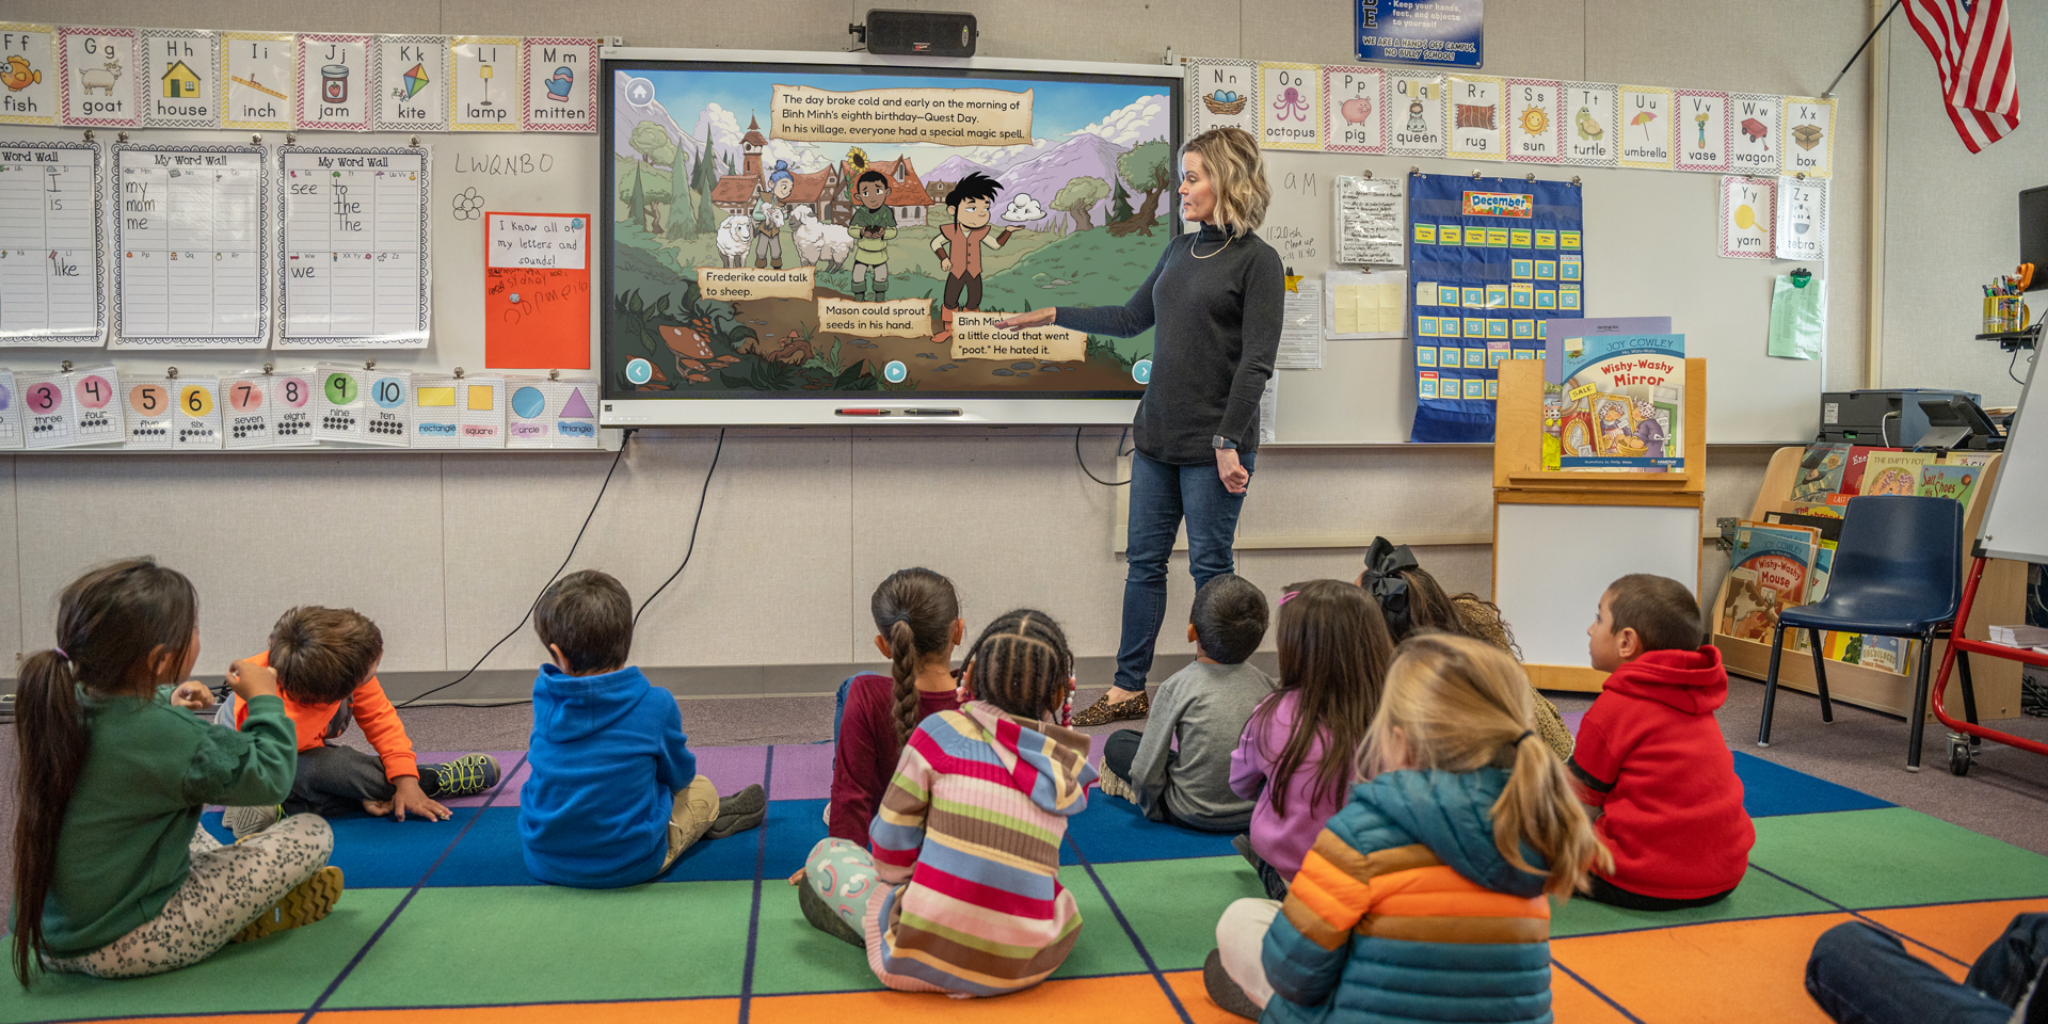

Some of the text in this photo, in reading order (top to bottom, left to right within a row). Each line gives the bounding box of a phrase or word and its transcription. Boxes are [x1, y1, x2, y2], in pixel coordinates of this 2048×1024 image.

[1393, 0, 1461, 13] Keep your hands,
[1392, 9, 1461, 21] feet, and objects
[1404, 20, 1437, 29] yourself
[1362, 36, 1376, 46] WE
[1377, 37, 1392, 47] ARE
[1394, 38, 1400, 47] A
[1402, 38, 1427, 49] HANDS
[1429, 41, 1443, 50] OFF
[1385, 47, 1455, 62] NO BULLY SCHOOL!
[4, 96, 37, 112] fish
[82, 99, 123, 115] goat
[157, 101, 207, 116] house
[782, 94, 1020, 111] The day broke cold and early on the morning of
[243, 102, 277, 118] inch
[318, 104, 350, 121] jam
[398, 104, 426, 119] kite
[466, 103, 507, 122] lamp
[534, 105, 586, 120] mitten
[807, 110, 839, 120] Minh's
[841, 111, 873, 122] eighth
[957, 113, 979, 125] Day.
[782, 124, 1025, 140] In his village, everyone had special magic spell.
[1266, 127, 1315, 143] octopus
[1345, 128, 1366, 143] pig
[1396, 130, 1438, 145] queen
[1466, 136, 1487, 150] rug
[1522, 141, 1546, 152] sun
[1573, 143, 1606, 156] turtle
[3, 152, 59, 162] Word Wall
[1624, 147, 1667, 159] umbrella
[1688, 150, 1717, 161] vase
[1735, 152, 1775, 166] wagon
[1796, 153, 1817, 167] box
[155, 155, 227, 166] My Word Wall
[318, 156, 388, 168] My Word Wall
[46, 173, 61, 192] I
[290, 183, 318, 195] see
[332, 179, 348, 195] to
[125, 182, 147, 202] my
[49, 194, 62, 211] is
[126, 199, 155, 212] mom
[333, 194, 361, 213] the
[1472, 195, 1526, 208] December
[127, 217, 149, 230] me
[499, 220, 504, 231] I
[543, 222, 558, 233] all
[497, 237, 577, 251] my letters and
[1737, 235, 1761, 248] yarn
[1788, 238, 1815, 250] zebra
[53, 257, 80, 277] like
[518, 254, 556, 268] sounds!
[290, 266, 315, 278] we
[706, 272, 808, 283] Frederike could talk
[706, 287, 753, 298] to sheep.
[1566, 296, 1574, 304] 10
[826, 305, 925, 318] Mason could sprout
[826, 320, 914, 330] seeds in his hand.
[967, 331, 1070, 341] little cloud that went
[993, 345, 1007, 354] He
[1009, 345, 1039, 355] hated
[1041, 345, 1050, 354] it.
[1606, 338, 1674, 352] JOY COWLEY
[1601, 359, 1674, 375] Wishy-Washy
[1614, 373, 1665, 387] Mirror
[85, 381, 100, 402] 4
[285, 381, 299, 402] 8
[333, 377, 347, 398] 9
[380, 381, 400, 402] 10
[1424, 384, 1433, 392] 25
[1468, 385, 1479, 393] 27
[1572, 385, 1592, 398] SALE
[36, 387, 53, 409] 3
[142, 388, 156, 410] 5
[188, 390, 202, 412] 6
[237, 386, 252, 407] 7
[34, 415, 63, 424] three
[284, 412, 307, 423] eight
[330, 408, 350, 418] nine
[380, 412, 395, 420] ten
[190, 420, 204, 428] six
[234, 416, 264, 425] seven
[418, 424, 457, 433] rectangle
[465, 427, 494, 436] square
[518, 425, 540, 434] circle
[561, 425, 592, 434] triangle
[1873, 456, 1926, 466] THE EMPTY POT
[1934, 482, 1956, 498] Shoes
[1762, 541, 1804, 553] JOY COWLEY
[1758, 559, 1802, 580] Wishy-Washy
[1761, 571, 1791, 588] Mouse
